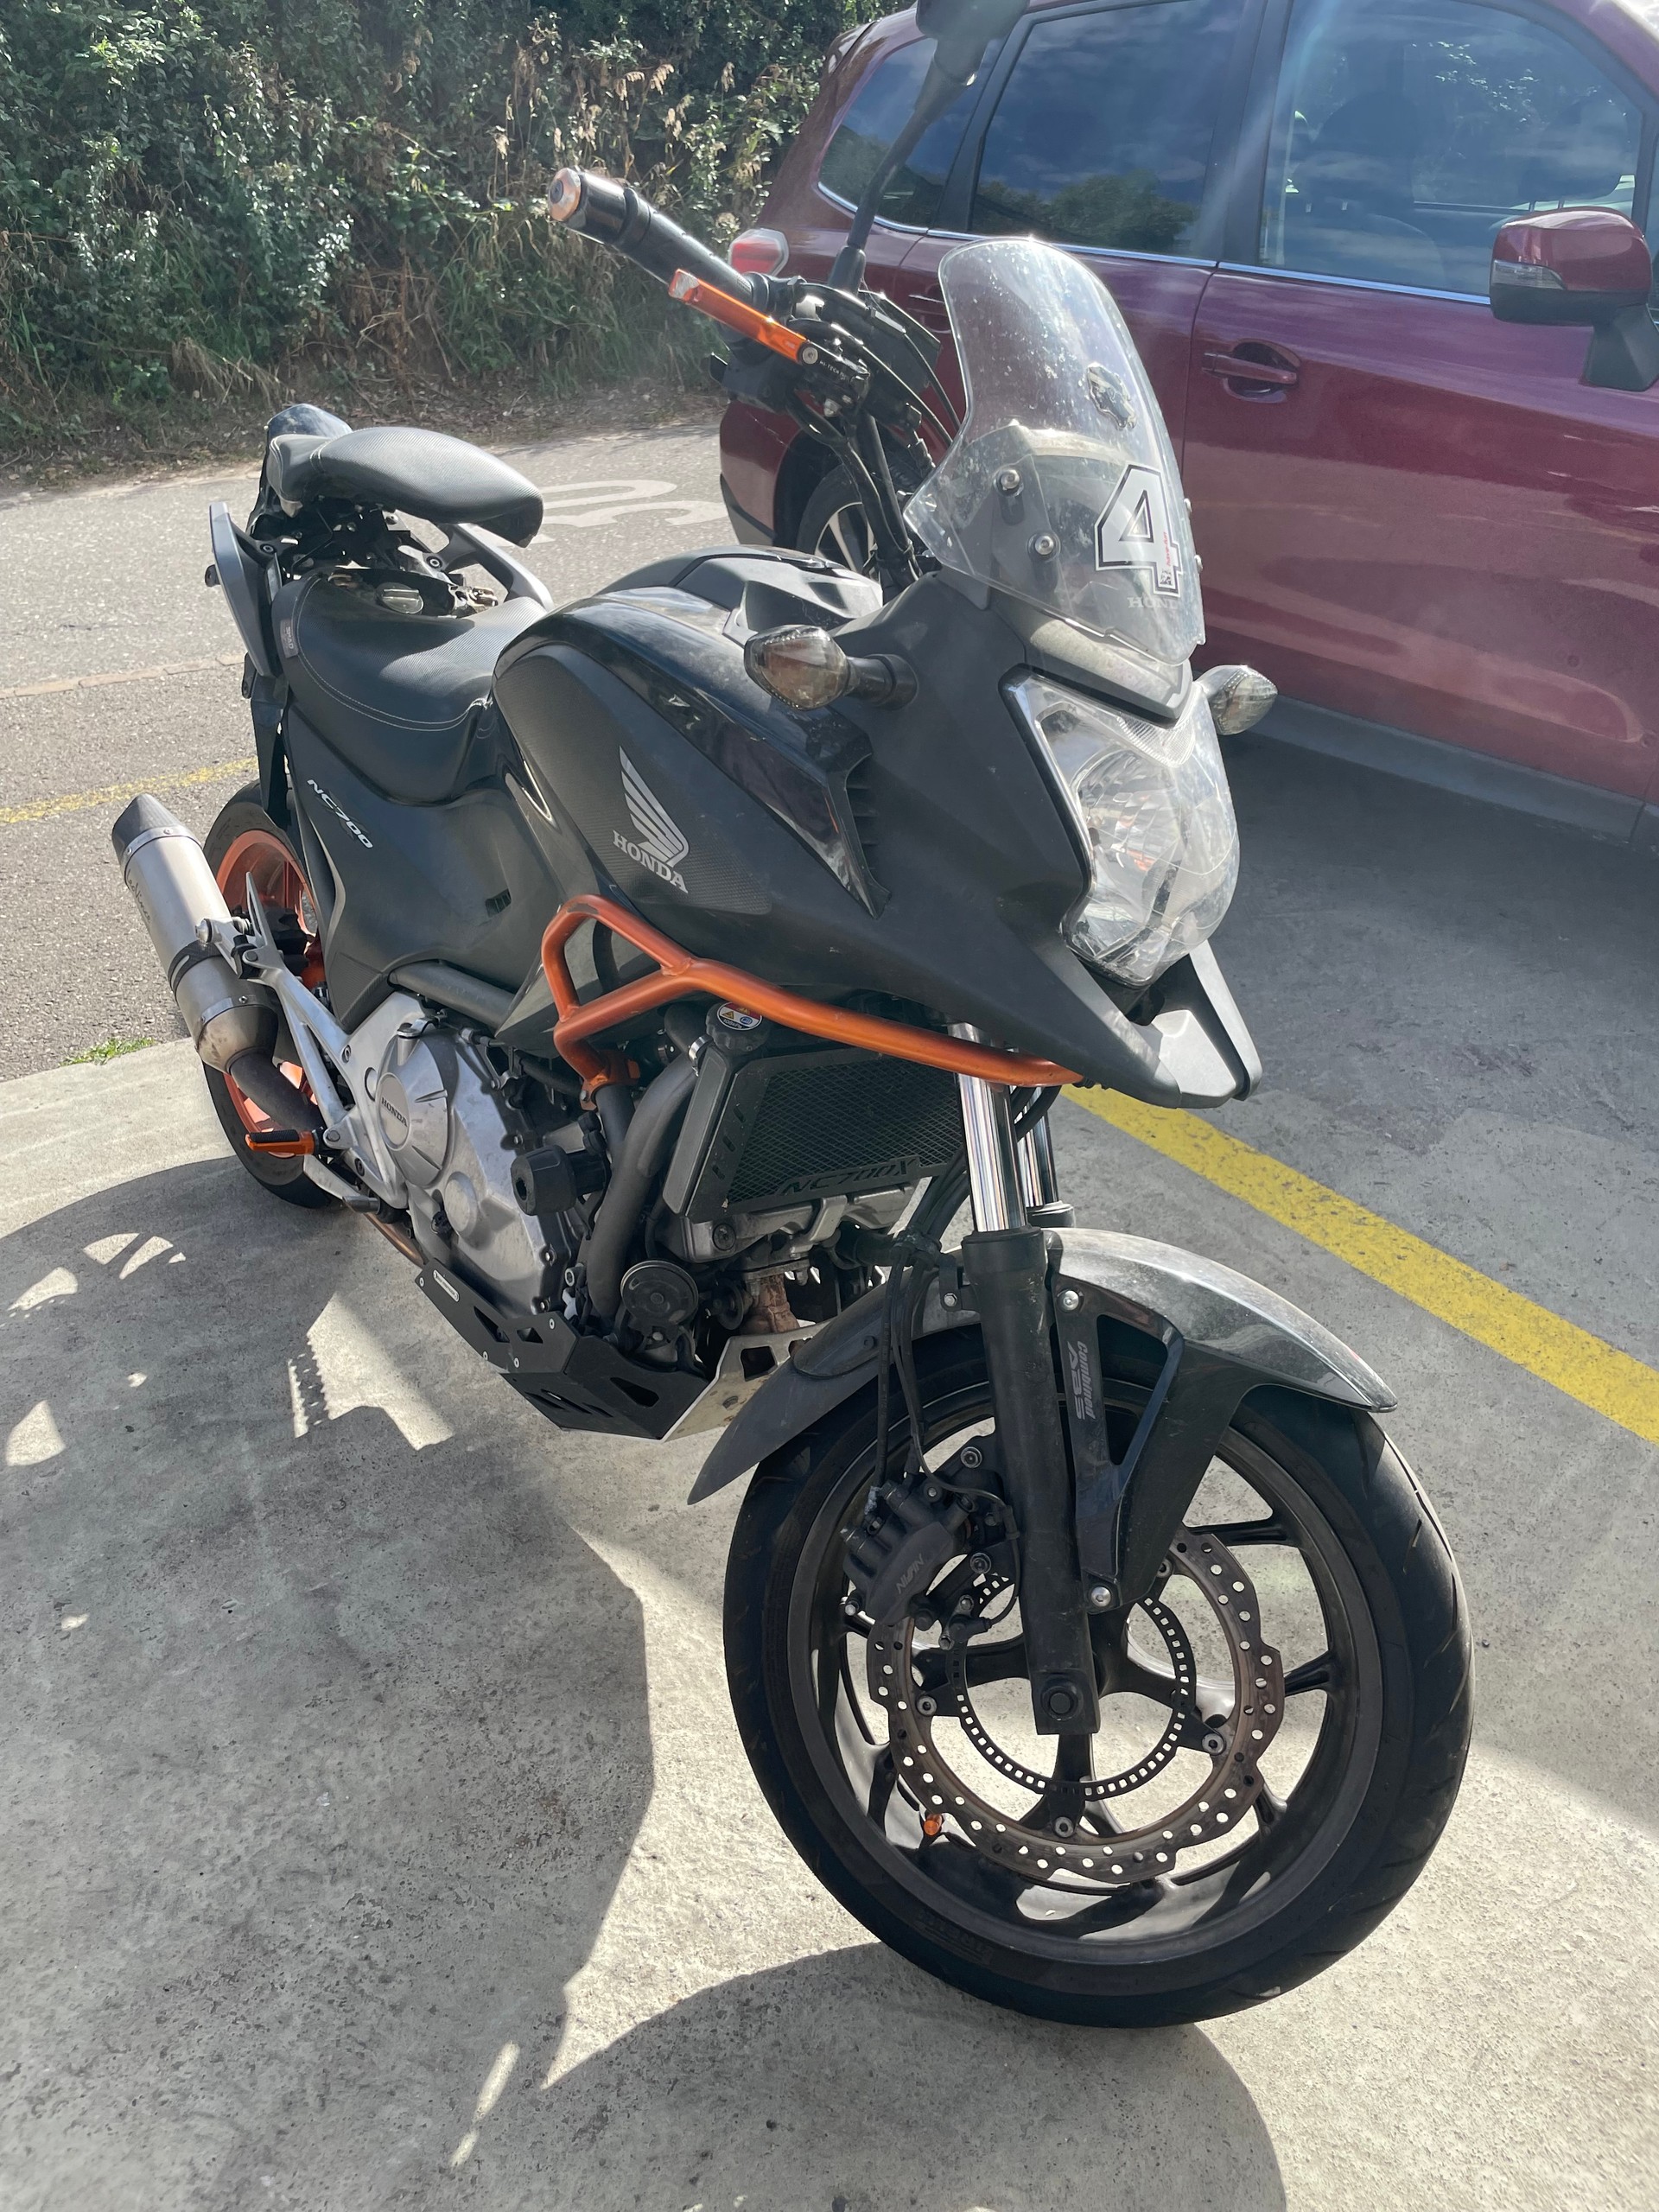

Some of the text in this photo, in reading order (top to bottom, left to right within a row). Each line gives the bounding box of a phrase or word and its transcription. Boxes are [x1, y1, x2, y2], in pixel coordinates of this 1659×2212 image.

[1097, 464, 1181, 594] 4
[307, 779, 373, 849] NC700
[613, 830, 689, 893] HONDA
[381, 1096, 408, 1128] HONDA
[1067, 1340, 1086, 1421] ABS
[1077, 1340, 1096, 1420] Combined
